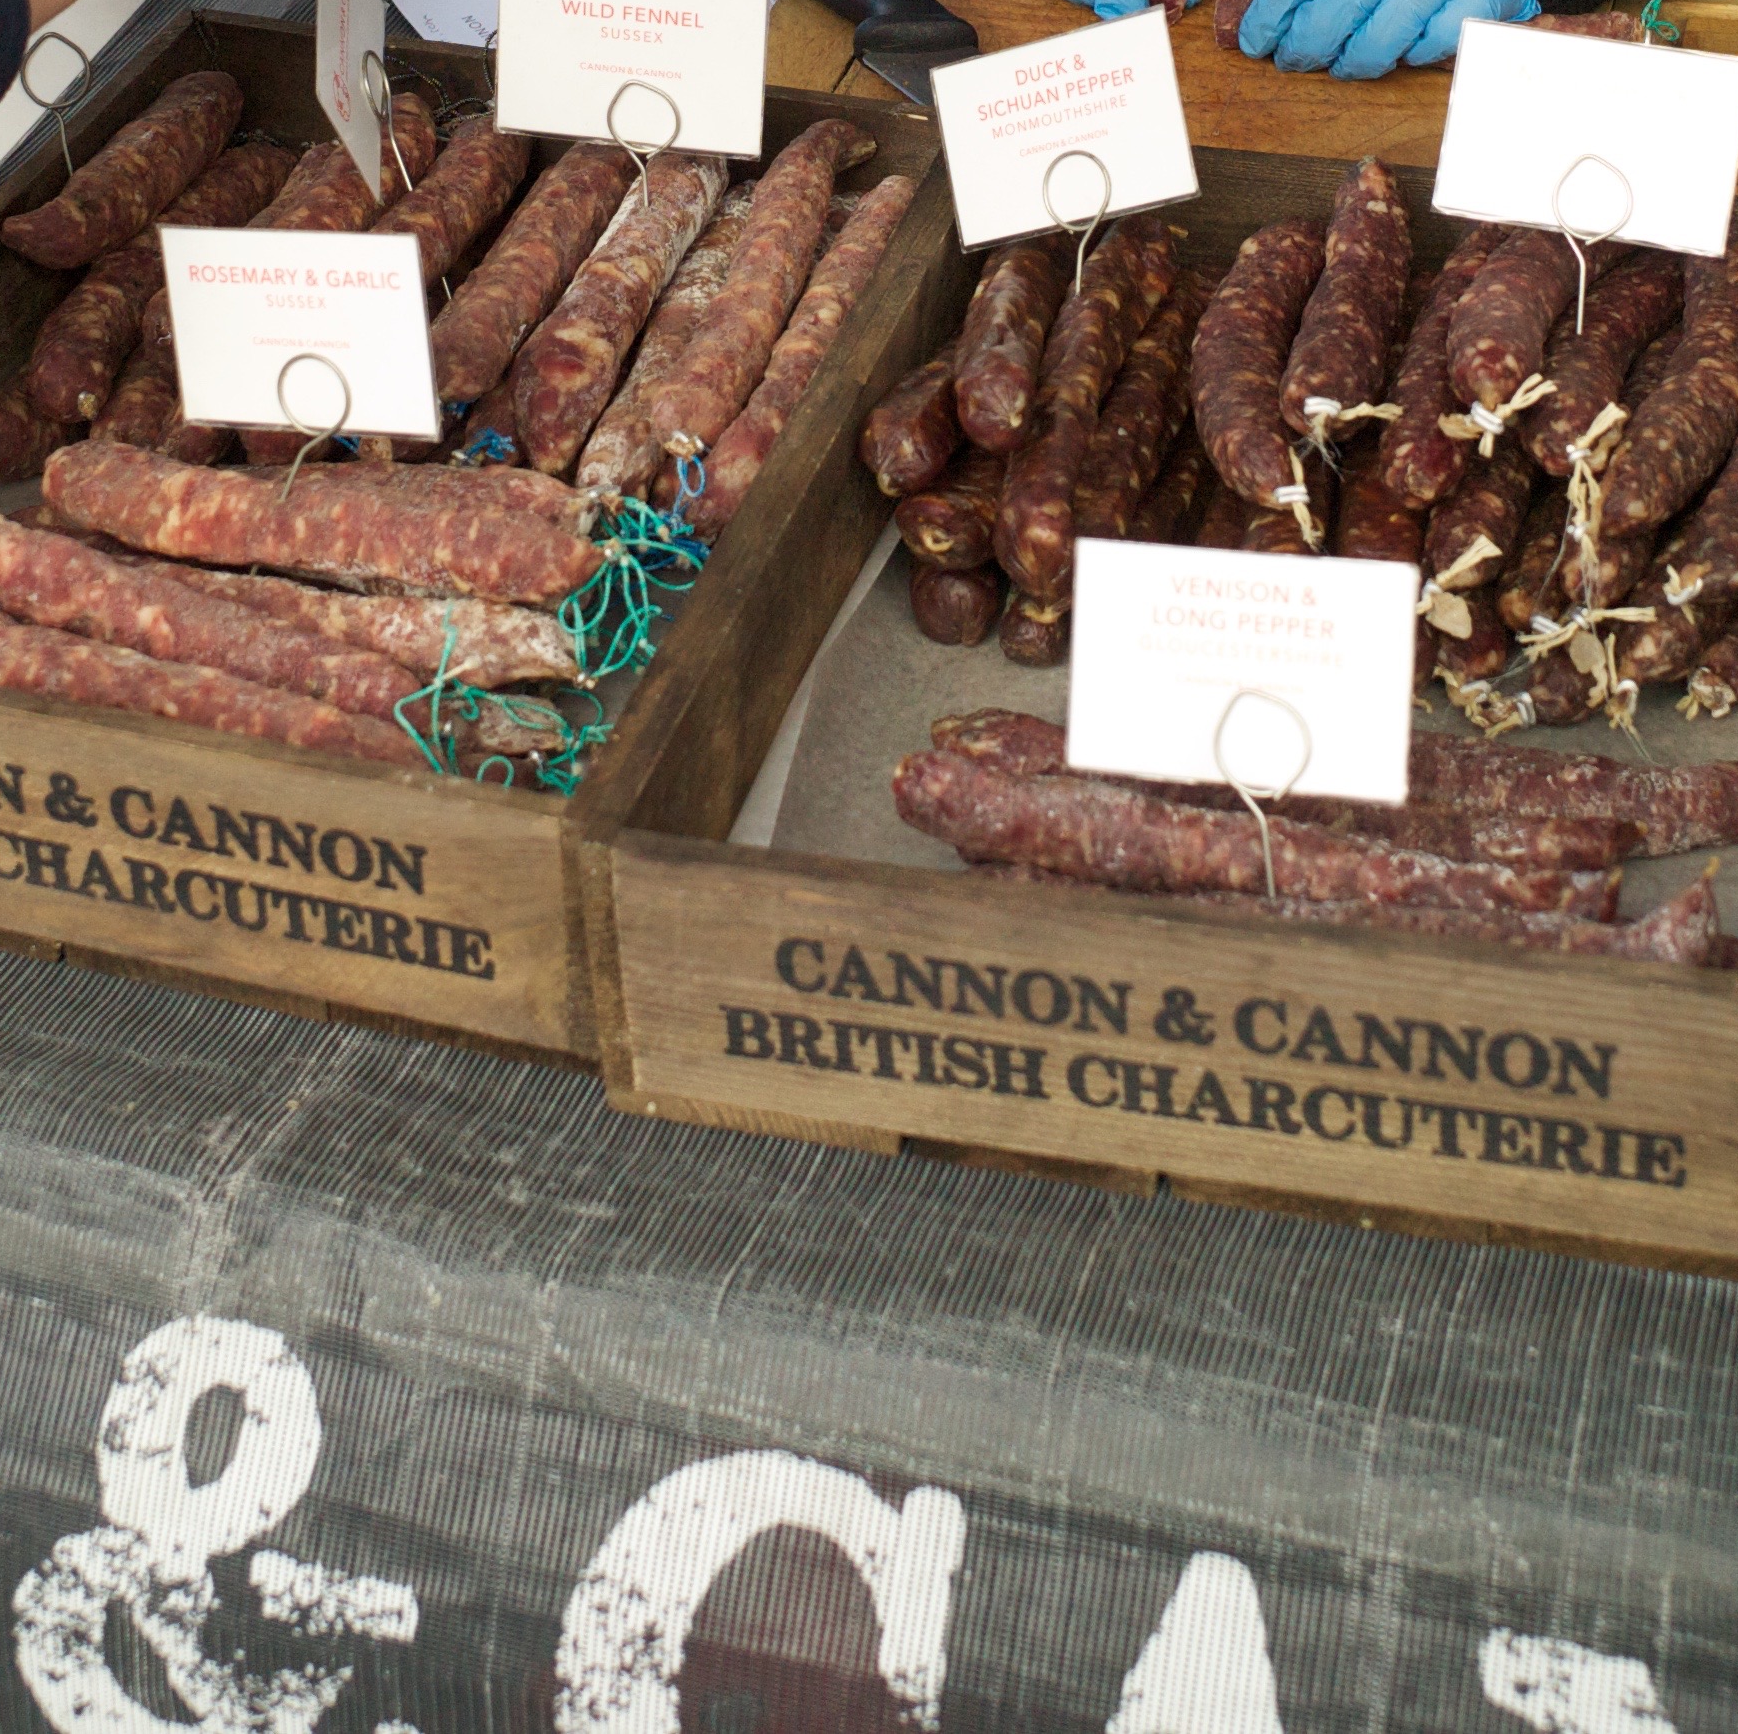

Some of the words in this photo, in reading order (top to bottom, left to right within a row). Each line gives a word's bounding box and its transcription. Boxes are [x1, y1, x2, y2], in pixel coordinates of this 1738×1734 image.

[561, 0, 614, 19] WILD
[623, 6, 704, 28] FENNEL
[600, 26, 663, 44] SUSSEX
[1015, 57, 1067, 86] DUCK
[1073, 54, 1086, 71] &
[977, 86, 1060, 122] SICHUAN
[1066, 67, 1135, 99] PEPPER
[991, 94, 1128, 140] MONMOUTHSHIRE
[188, 264, 298, 286] ROSEMARY
[305, 269, 319, 287] &
[325, 269, 401, 290] GARLIC
[265, 293, 327, 310] SUSSEX
[1170, 575, 1291, 605] VENISON
[1301, 586, 1319, 607] &
[1151, 605, 1227, 632] LONG
[1237, 613, 1336, 640] PEPPER
[43, 772, 99, 828] &
[111, 785, 428, 896] CANNON
[775, 935, 1133, 1036] CANNON
[1152, 984, 1215, 1047] &
[1233, 999, 1618, 1101] CANNON
[718, 1004, 1050, 1100] BRITISH
[1066, 1053, 1688, 1188] CHARCUTERIE
